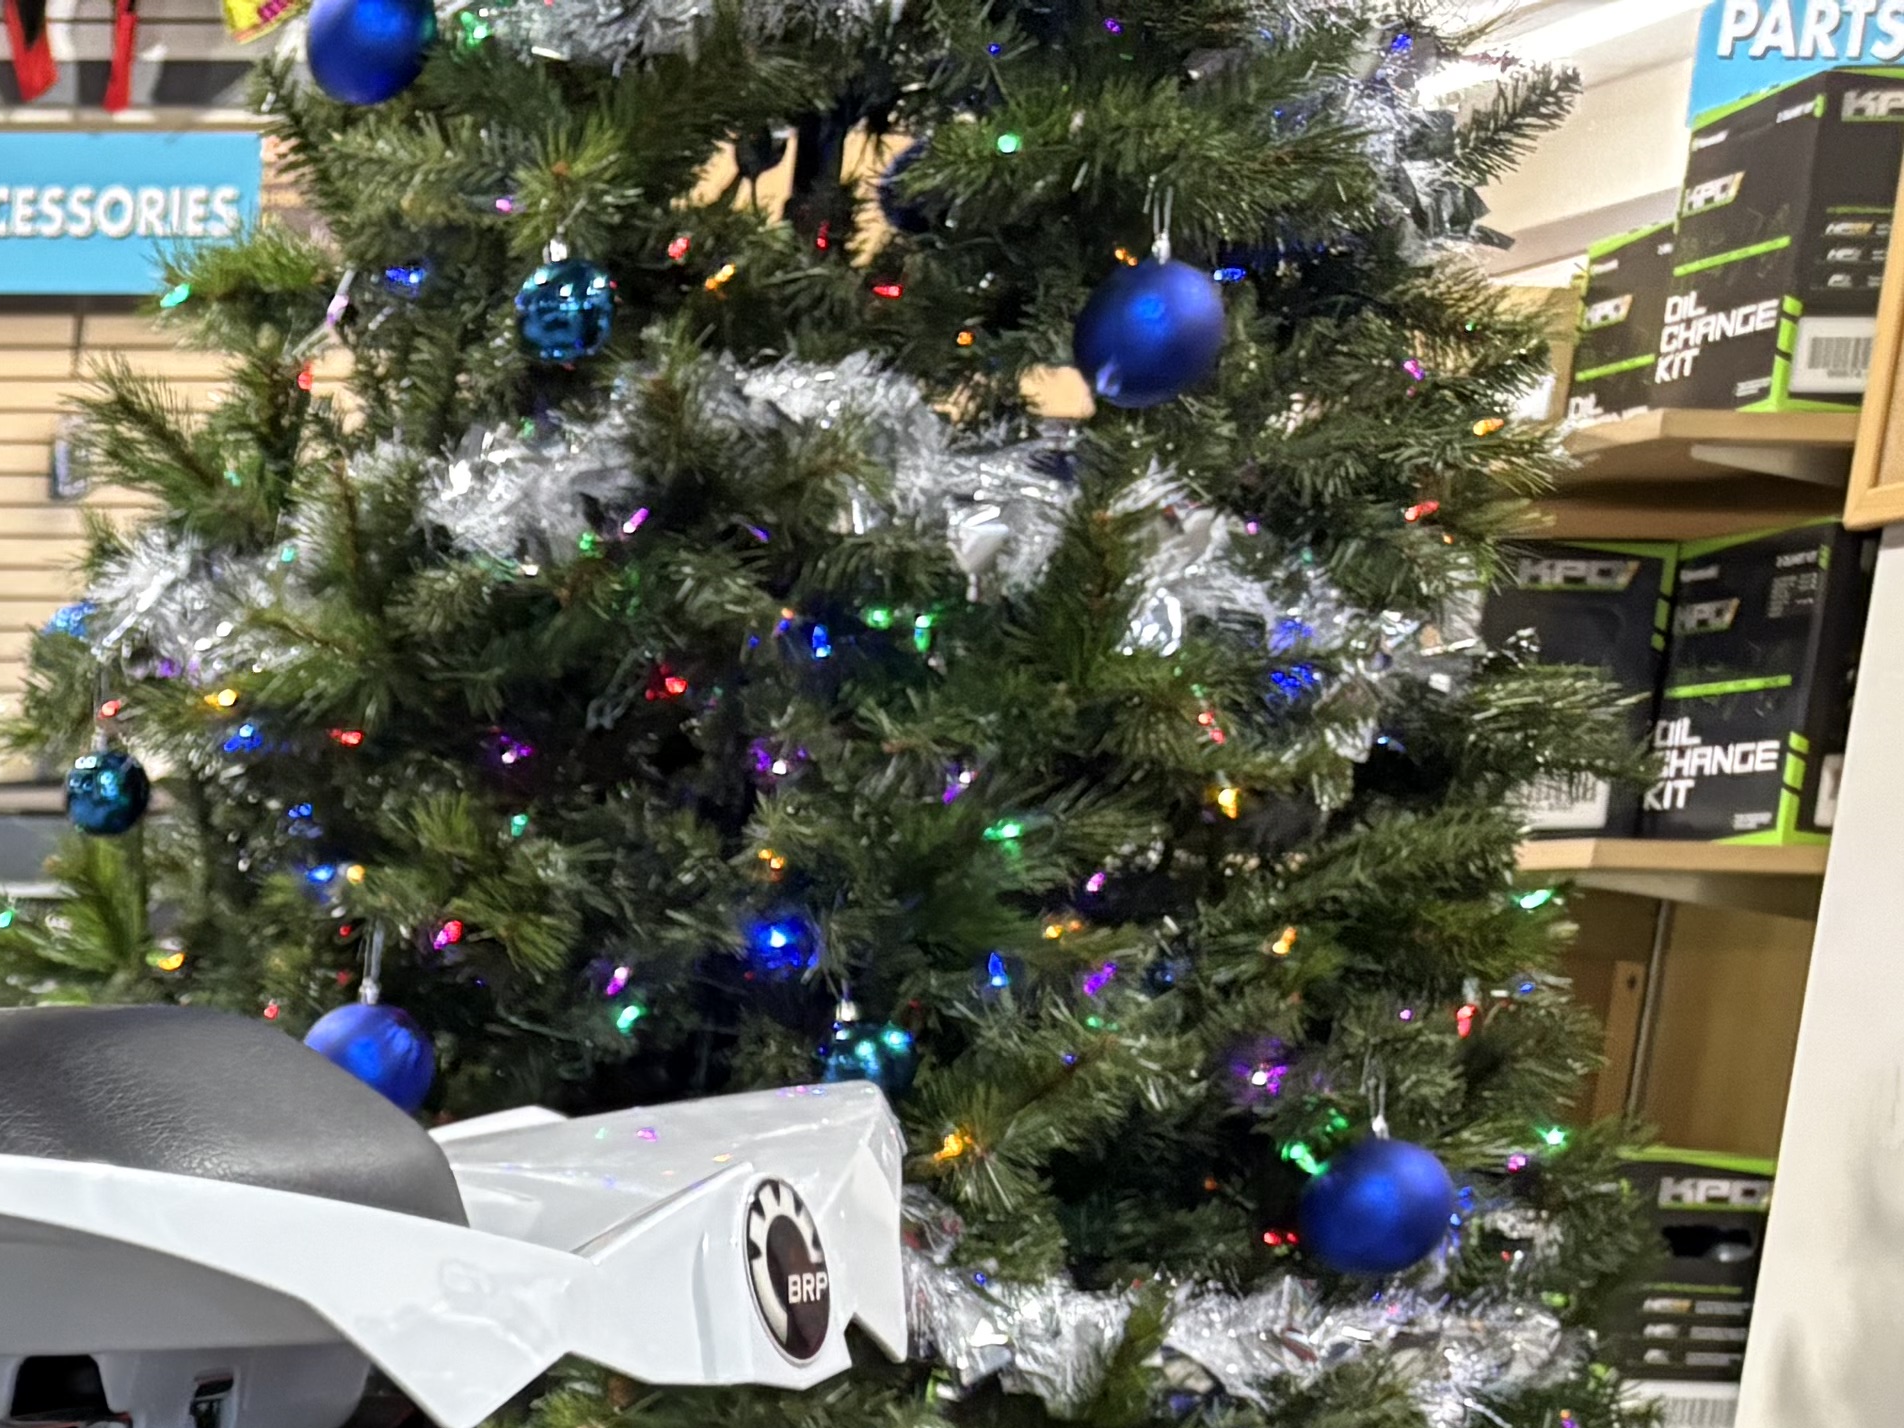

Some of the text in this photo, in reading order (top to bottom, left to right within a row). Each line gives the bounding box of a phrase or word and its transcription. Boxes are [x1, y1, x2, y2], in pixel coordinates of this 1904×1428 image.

[1664, 292, 1707, 324] OIL
[1660, 298, 1780, 354] CHANGE
[1655, 348, 1699, 384] KIT
[1654, 717, 1701, 747] OIL
[1643, 780, 1695, 810] KIT
[788, 1271, 829, 1304] BRP
